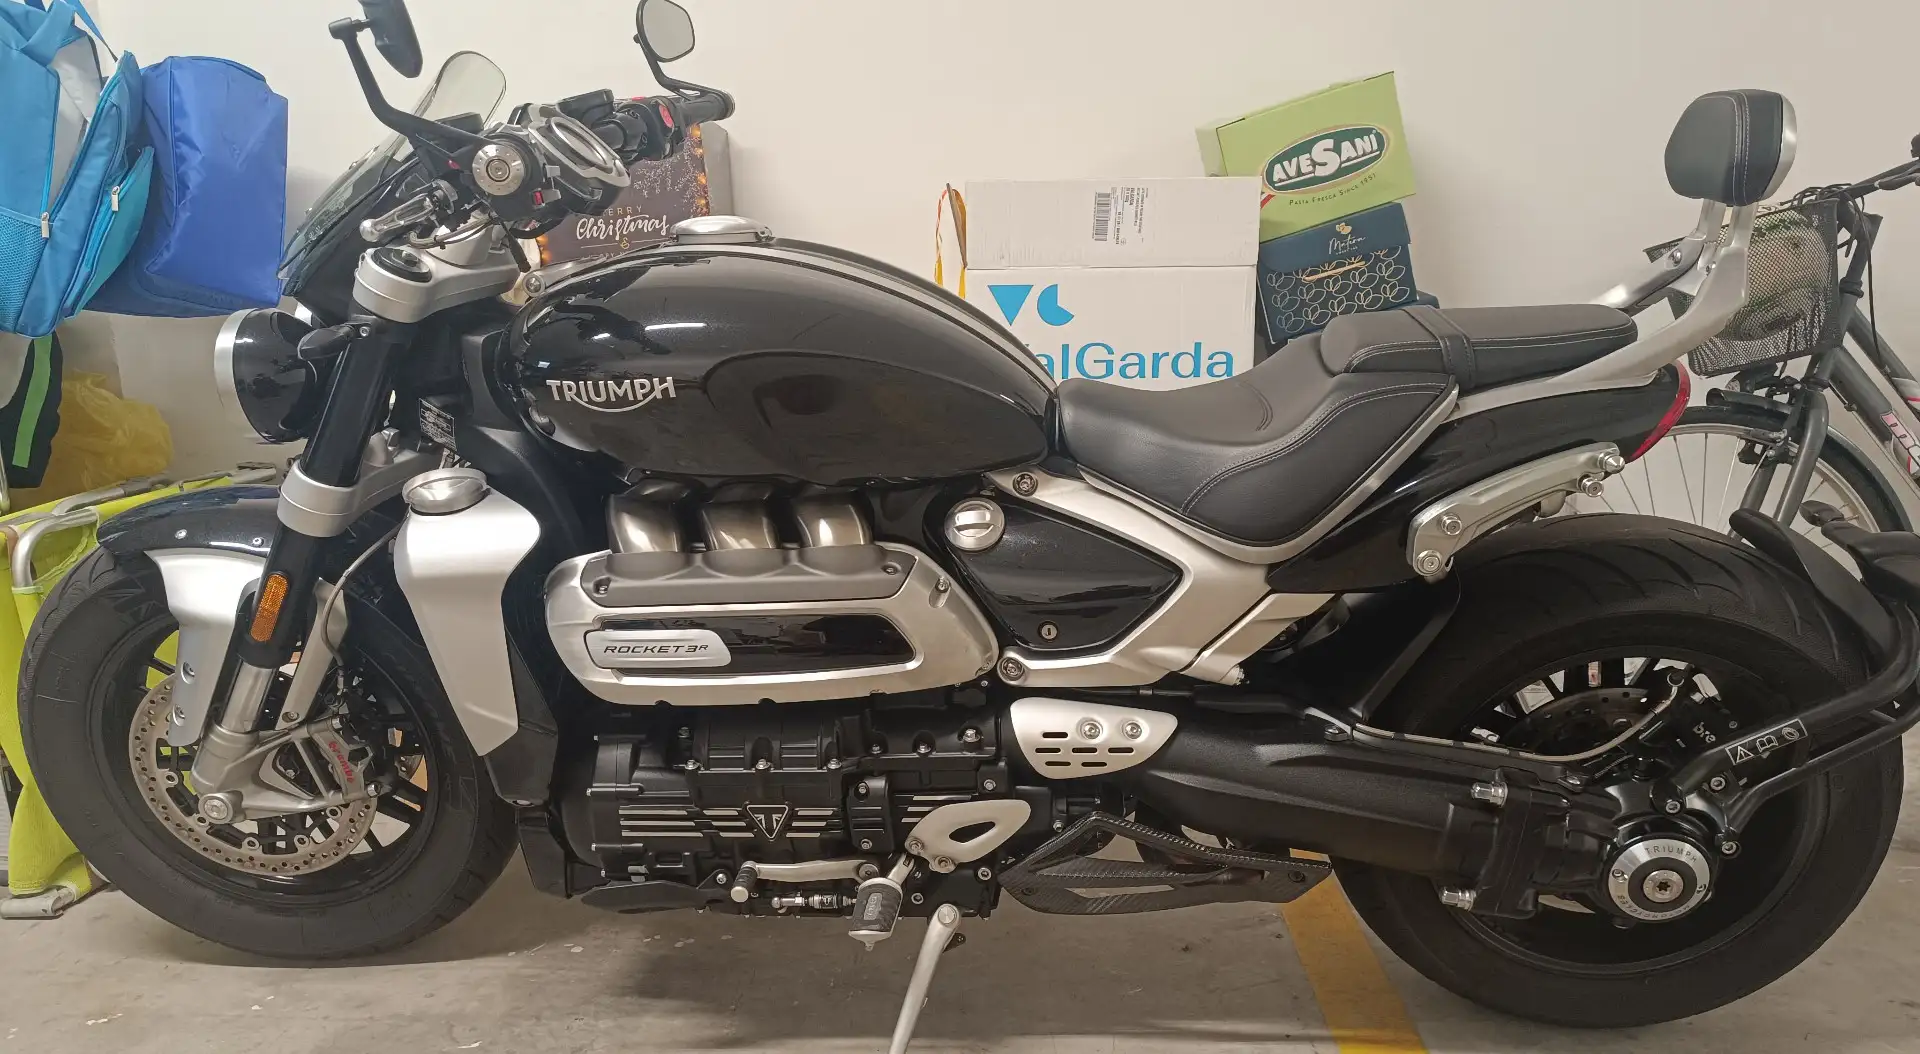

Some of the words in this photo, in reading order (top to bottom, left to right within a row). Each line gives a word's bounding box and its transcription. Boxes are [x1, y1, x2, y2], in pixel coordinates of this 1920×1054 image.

[603, 205, 642, 217] ERRY
[576, 215, 670, 241] Christmas
[1026, 342, 1234, 380] alGarda
[546, 376, 677, 412] TRIUMPH
[1645, 845, 1697, 862] TRIUMPH
